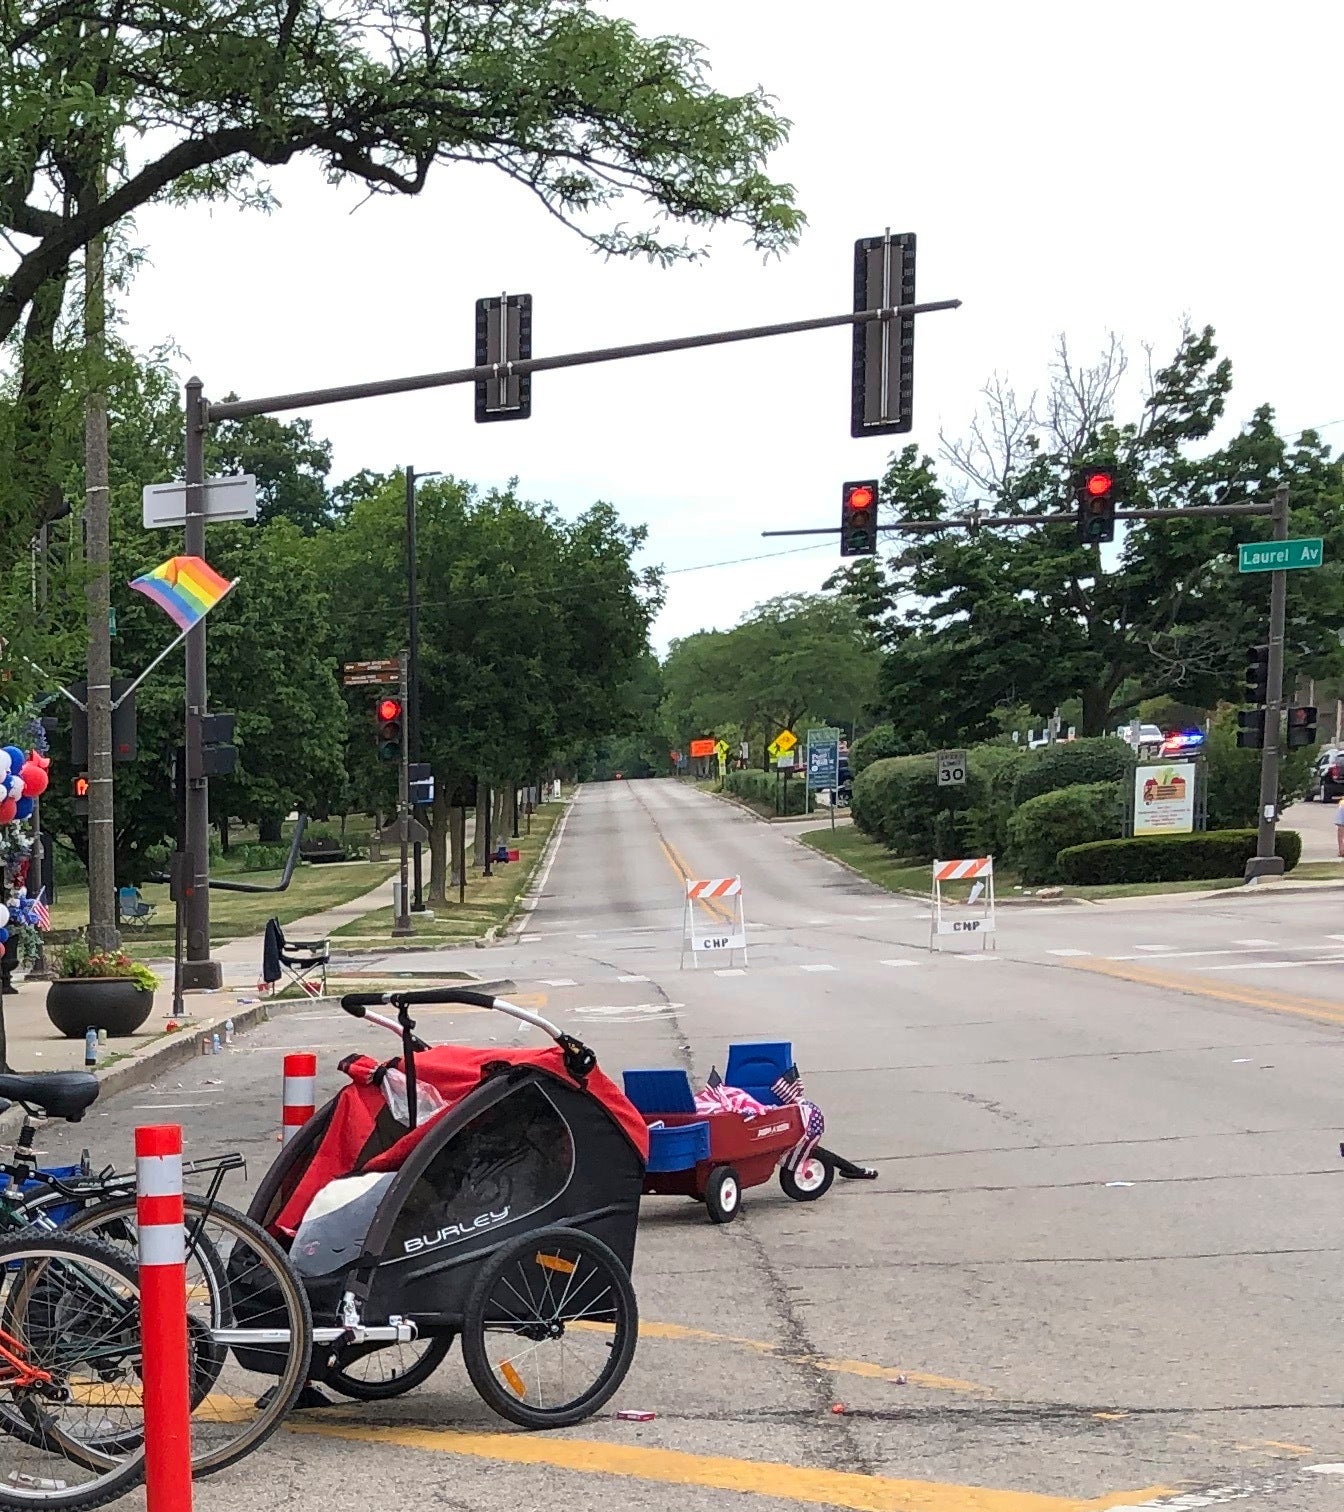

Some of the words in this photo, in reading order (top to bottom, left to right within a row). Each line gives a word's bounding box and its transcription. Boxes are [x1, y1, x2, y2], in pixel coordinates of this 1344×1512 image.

[1243, 548, 1289, 565] Laurel
[1301, 546, 1319, 560] Av
[941, 768, 964, 782] 30
[403, 1206, 510, 1253] BURLEY
